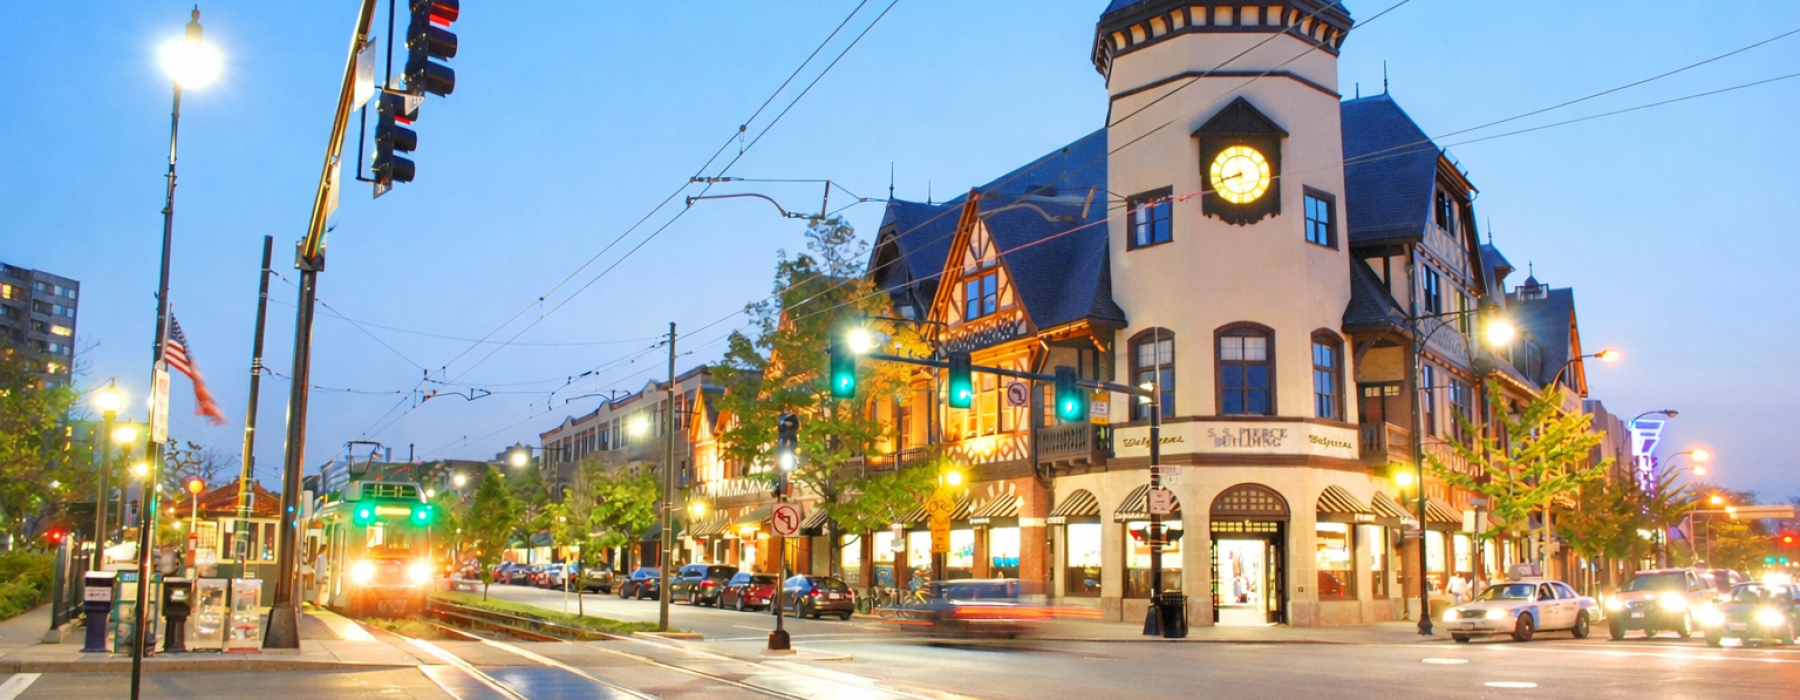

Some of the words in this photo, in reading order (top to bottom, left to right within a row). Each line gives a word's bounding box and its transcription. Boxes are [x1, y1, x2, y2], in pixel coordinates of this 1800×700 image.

[1240, 427, 1288, 438] PIERCE
[1123, 435, 1185, 448] Walgeens
[1214, 436, 1281, 448] BUILDING
[1308, 434, 1353, 449] Walgreens
